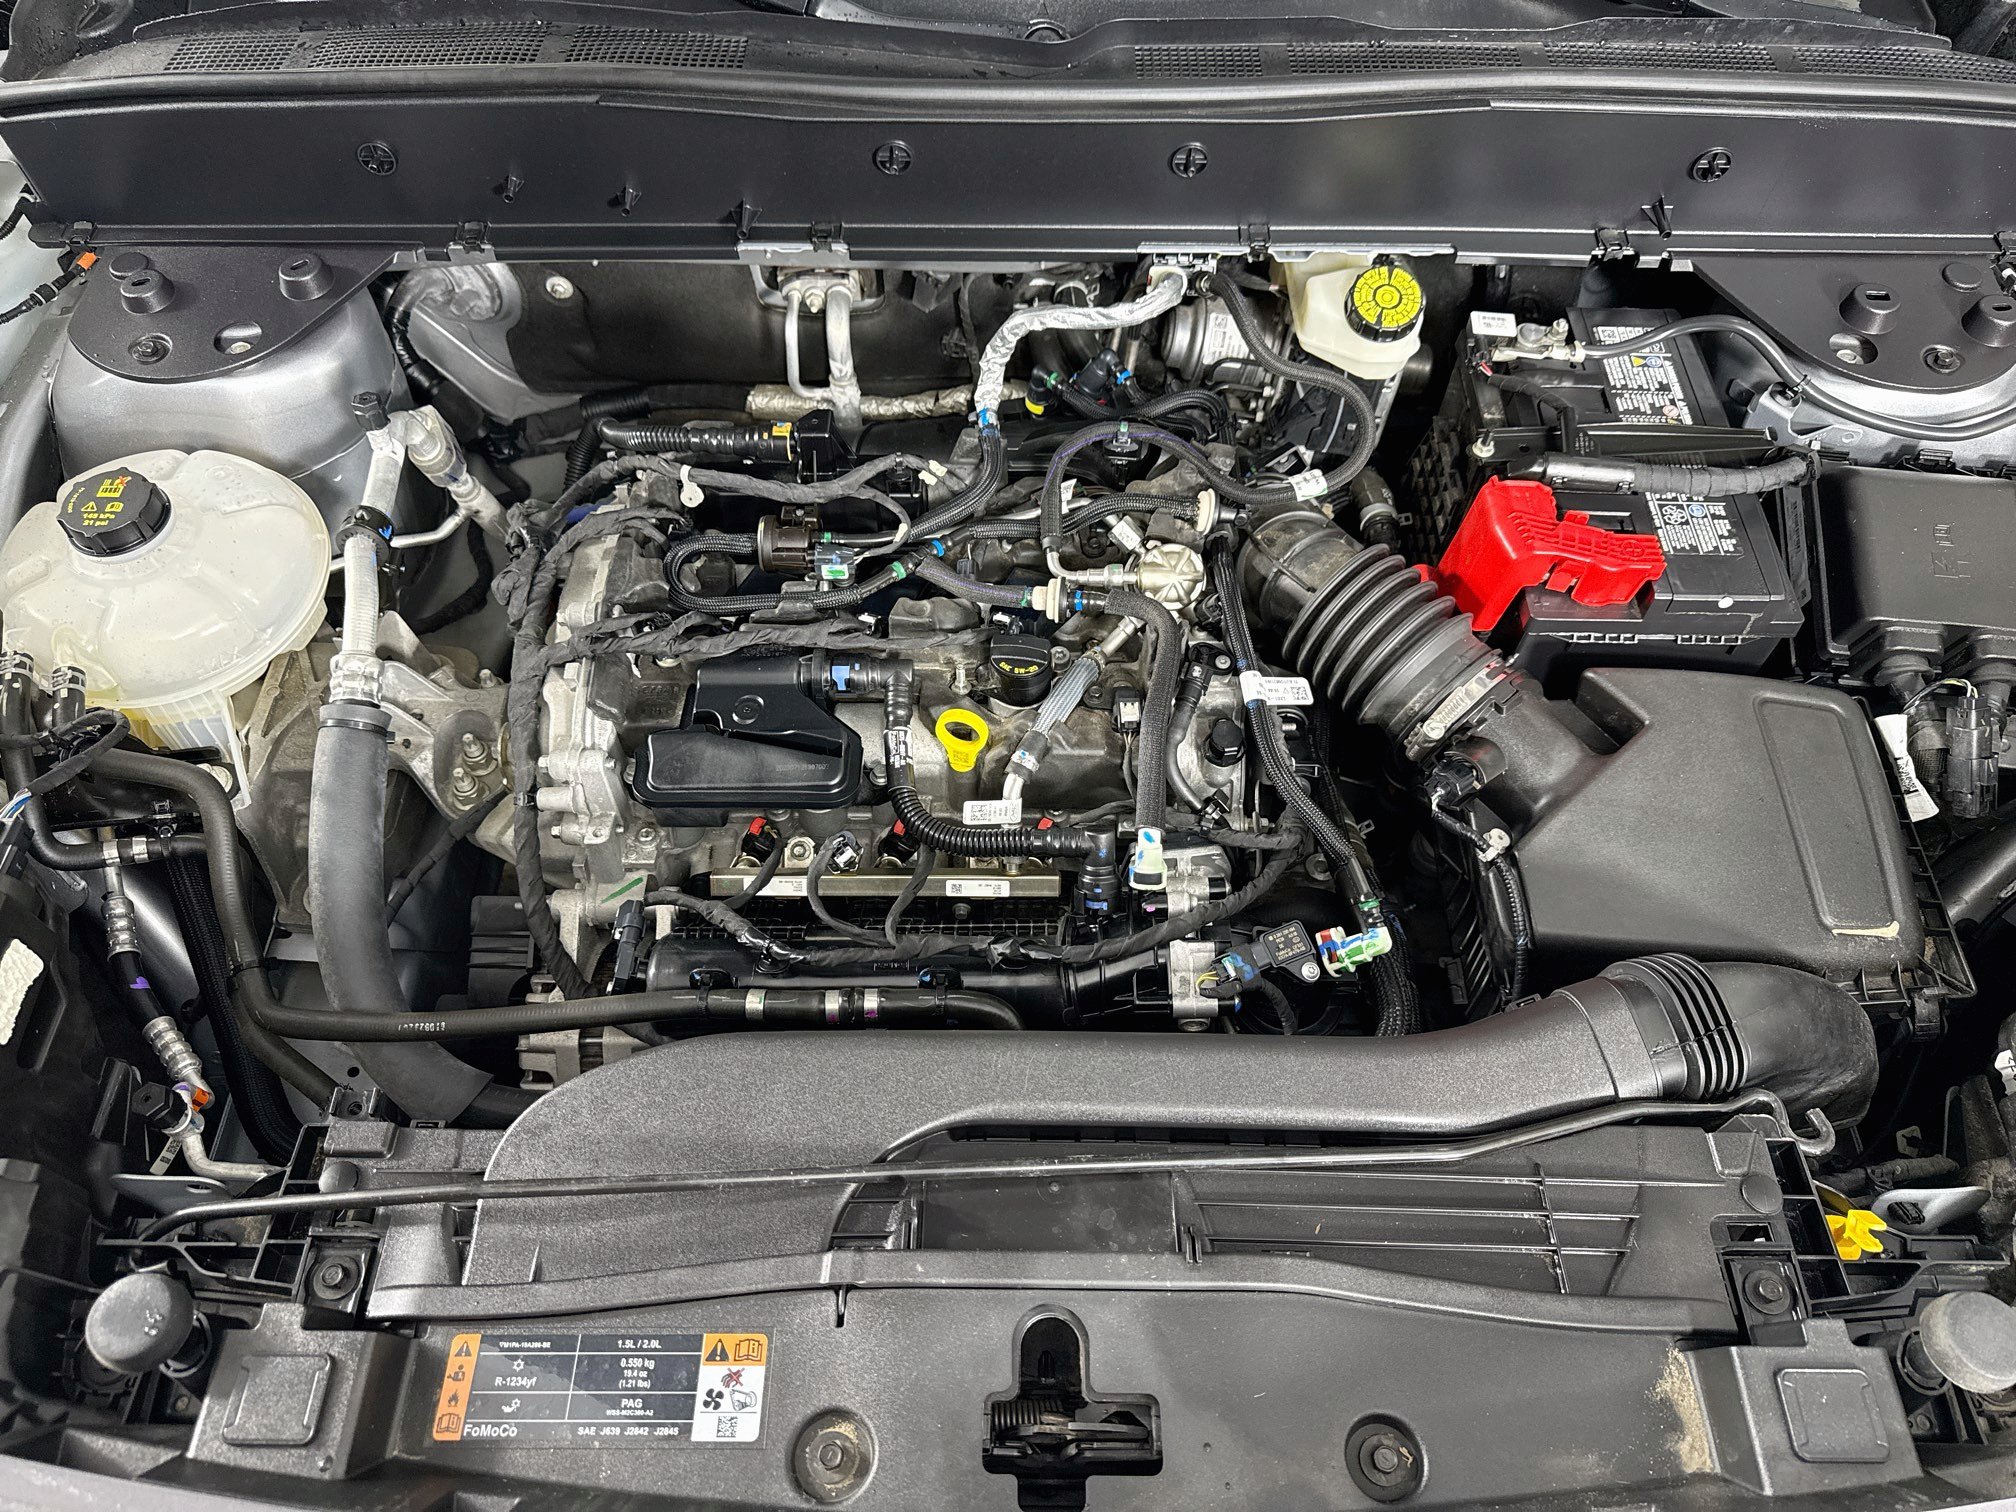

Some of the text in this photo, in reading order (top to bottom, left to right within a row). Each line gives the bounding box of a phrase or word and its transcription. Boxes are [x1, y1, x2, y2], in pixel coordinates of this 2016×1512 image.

[999, 661, 1012, 672] SAE
[617, 1339, 635, 1349] 1.5L
[642, 1339, 662, 1349] 2.0L
[620, 1358, 655, 1370] 0.550 kg
[623, 1369, 648, 1378] 19.4 oz
[494, 1376, 537, 1389] R-1234yf
[618, 1379, 651, 1389] (1.21 lbs)
[621, 1398, 643, 1408] PAG
[463, 1424, 518, 1437] FoMoCo
[577, 1426, 679, 1436] SAE J639 J2842 J2845
